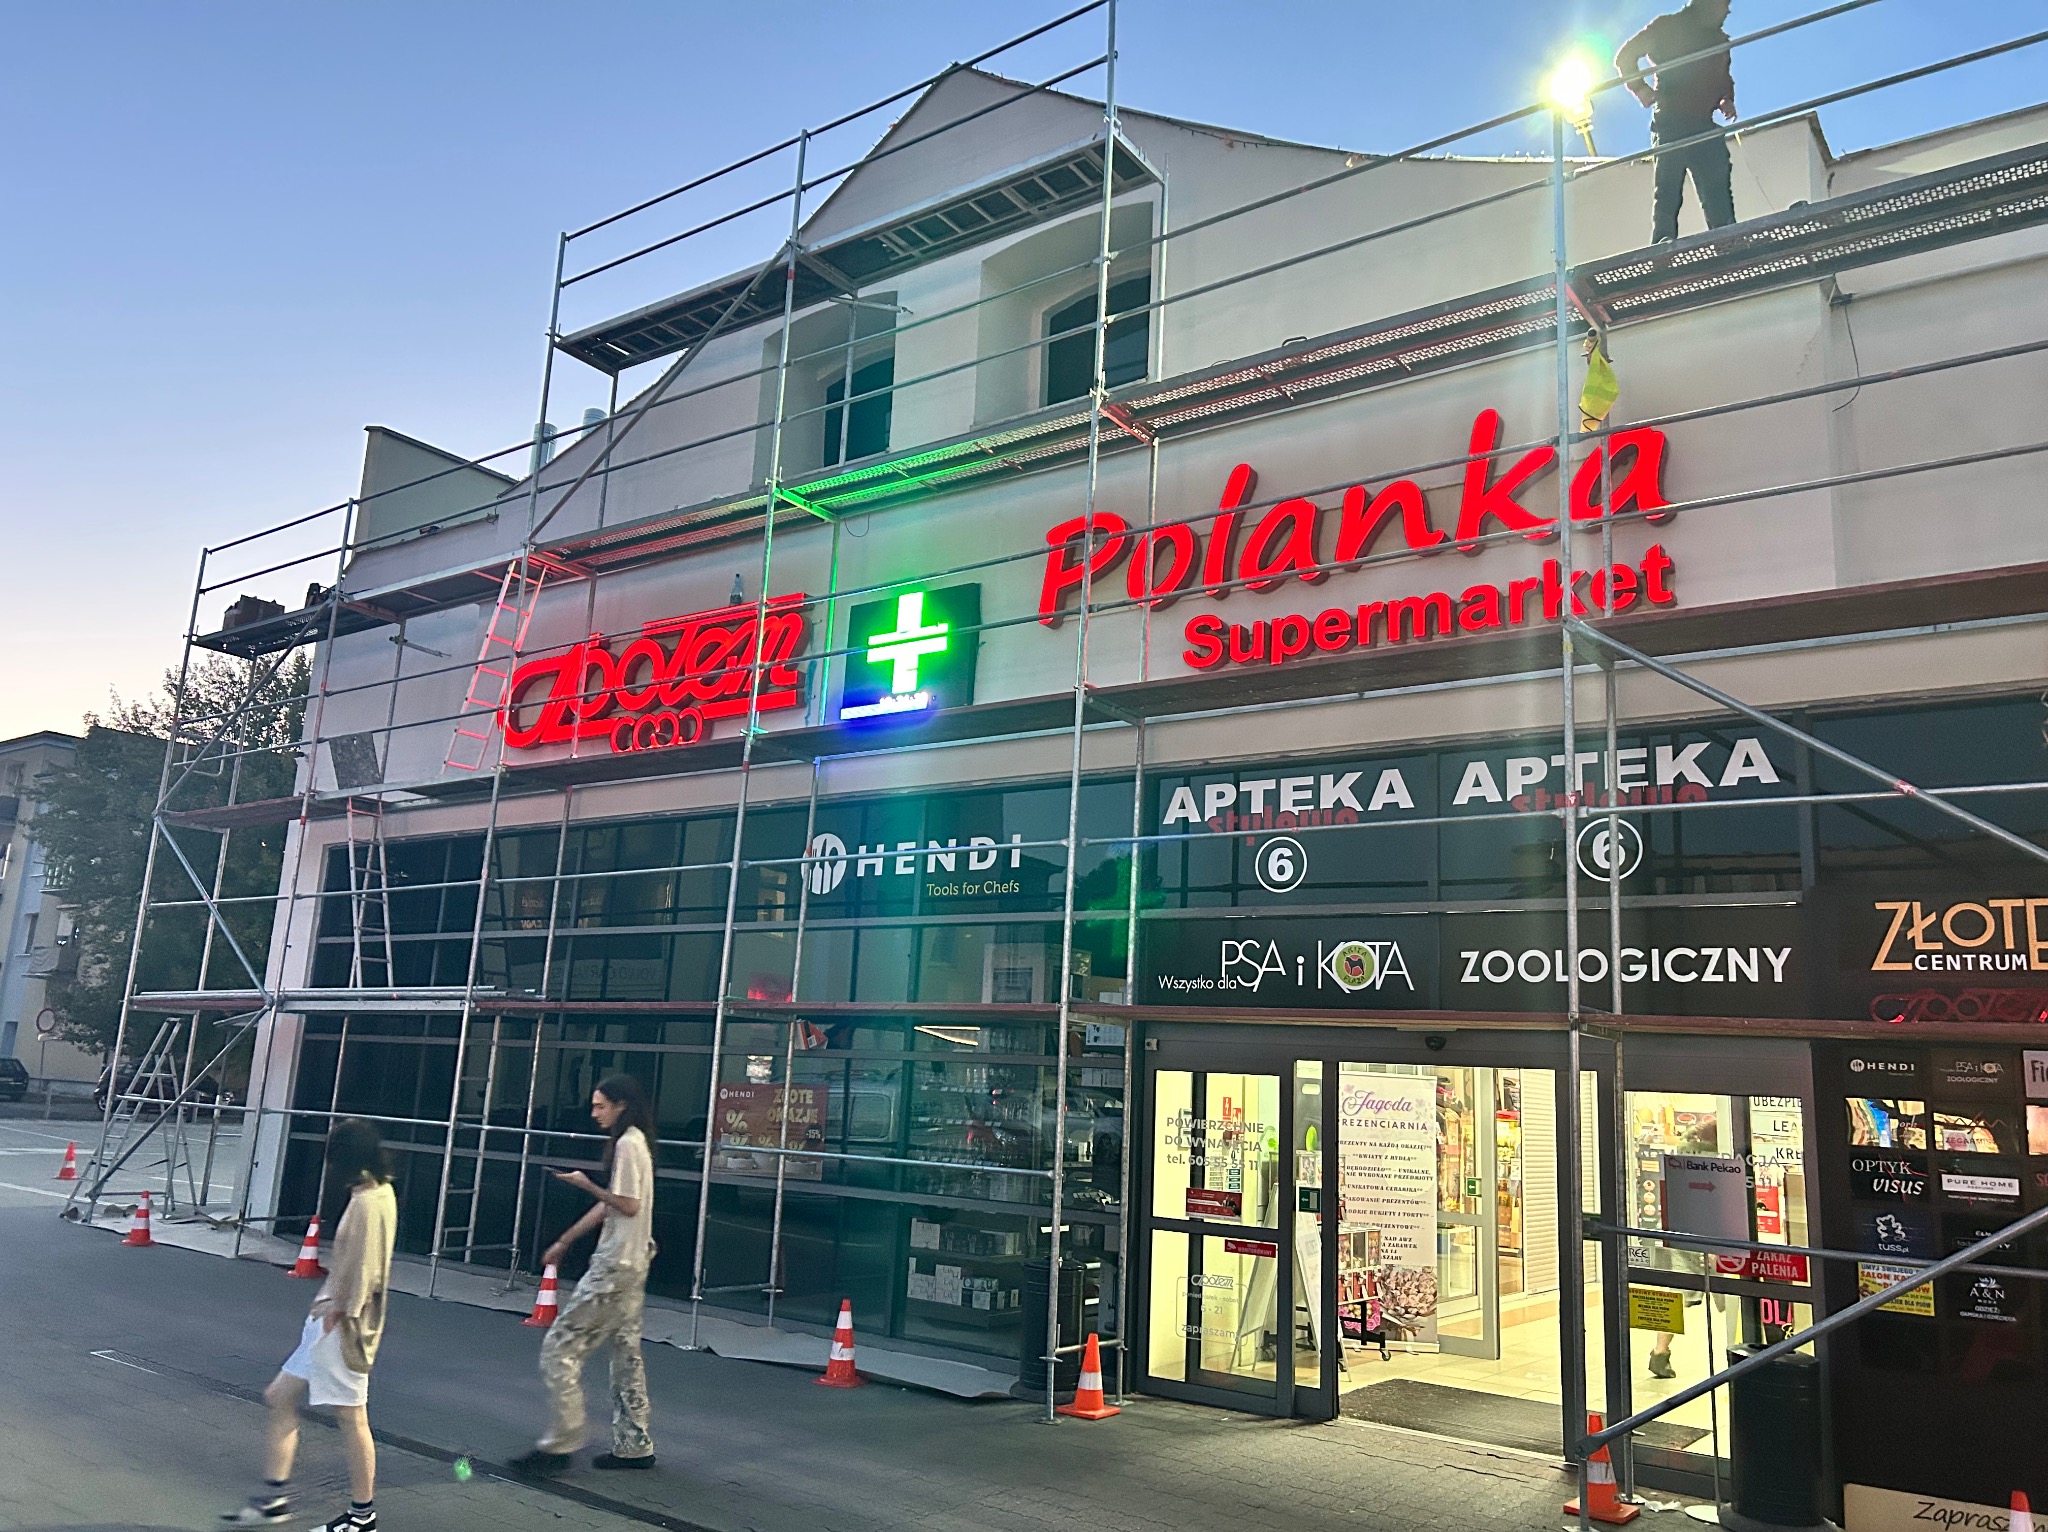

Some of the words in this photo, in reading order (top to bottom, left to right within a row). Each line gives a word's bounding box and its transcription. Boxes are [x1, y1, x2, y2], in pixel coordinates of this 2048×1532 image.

[1039, 409, 1668, 626] Polanka
[1183, 544, 1673, 669] Supermarket
[1453, 738, 1779, 805] APTEKA
[1163, 769, 1414, 825] APTEKA
[857, 834, 1022, 877] HENDI
[1592, 830, 1626, 869] 6
[1268, 847, 1294, 881] 6
[927, 883, 958, 897] Tools
[963, 882, 980, 895] for
[984, 880, 1020, 894] Chefs
[1871, 899, 2048, 971] ZŁOTE
[1221, 939, 1287, 993] PSA
[1296, 955, 1305, 986] i
[1317, 940, 1415, 994] KOTA
[1460, 947, 1792, 983] ZOOLOGICZNY
[1914, 954, 2028, 971] CENTRUM
[1158, 974, 1214, 993] Wszystko
[1217, 974, 1237, 989] dla
[1867, 1062, 1915, 1071] HENDI
[2030, 1059, 2048, 1082] Fi
[728, 1090, 755, 1098] HENDI
[773, 1088, 814, 1104] ZOTE
[1342, 1090, 1413, 1117] Jagoda
[1166, 1117, 1264, 1134] POWIERZCHNIE
[1341, 1118, 1428, 1131] REZENCIARNIA
[1164, 1135, 1182, 1147] DO
[1166, 1153, 1186, 1165] tel.
[1188, 1155, 1210, 1167] 605
[1686, 1160, 1709, 1171] Bank
[1710, 1162, 1741, 1174] Pekao
[1852, 1159, 1912, 1175] OPTYK
[1873, 1178, 1925, 1196] VISUS
[1751, 1262, 1799, 1279] PALENIA
[1860, 1270, 1891, 1281] SALON
[1862, 1263, 1880, 1271] UMYJ
[1881, 1265, 1914, 1275] SWOJEGO
[1969, 1287, 1980, 1297] A
[1995, 1289, 2005, 1299] N
[1913, 1501, 2048, 1532] Zaprasz
